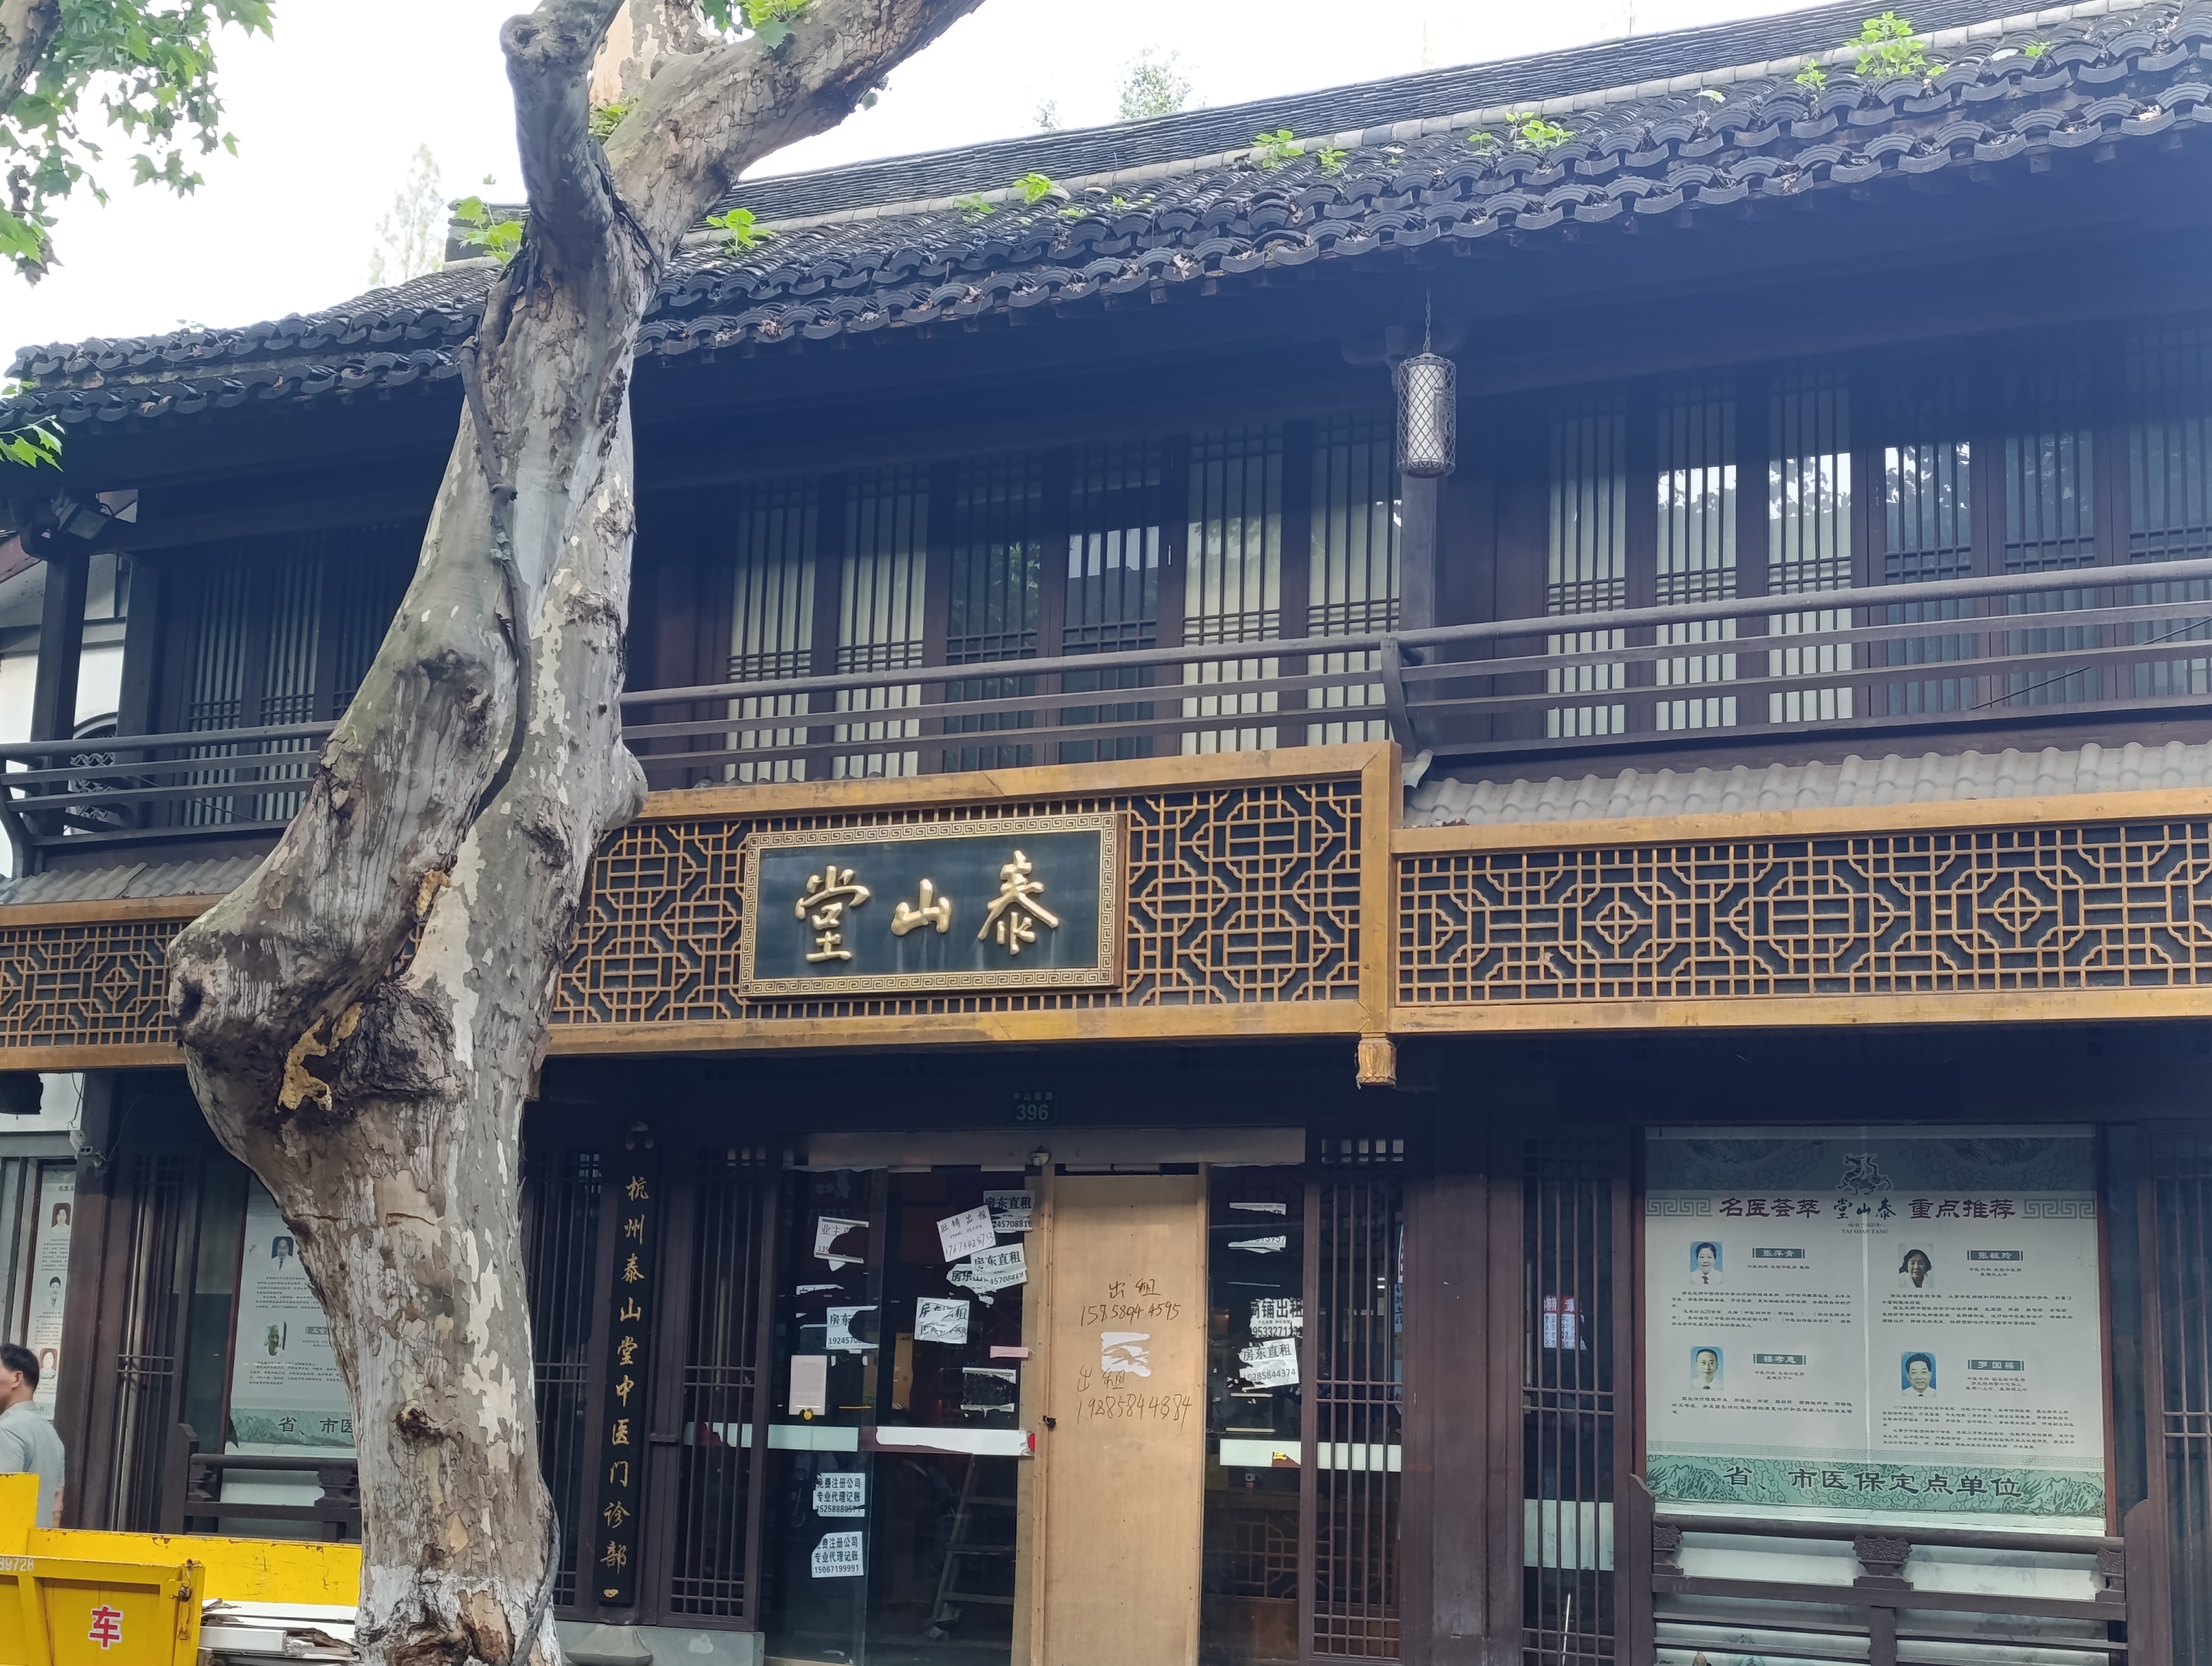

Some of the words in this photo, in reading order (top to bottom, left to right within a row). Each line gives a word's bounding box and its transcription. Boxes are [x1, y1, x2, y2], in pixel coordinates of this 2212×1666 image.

[1017, 1104, 1049, 1121] 396
[1719, 1197, 1821, 1219] 名医荟萃
[1908, 1199, 2016, 1219] 重点推荐
[1109, 1278, 1161, 1298] 出租
[830, 1313, 856, 1326] 房东
[1243, 1343, 1292, 1361] 房东直租
[600, 1175, 650, 1574] 杭州泰山堂中医门诊部
[1077, 1365, 1126, 1392] 出租
[817, 1477, 860, 1489] 免费注册公司
[816, 1491, 860, 1502] 专业代理记账
[818, 1536, 858, 1549] 费注册公司
[814, 1550, 858, 1563] 专业代理记账
[814, 1564, 859, 1573] 15067199991
[89, 1606, 120, 1647] 车
